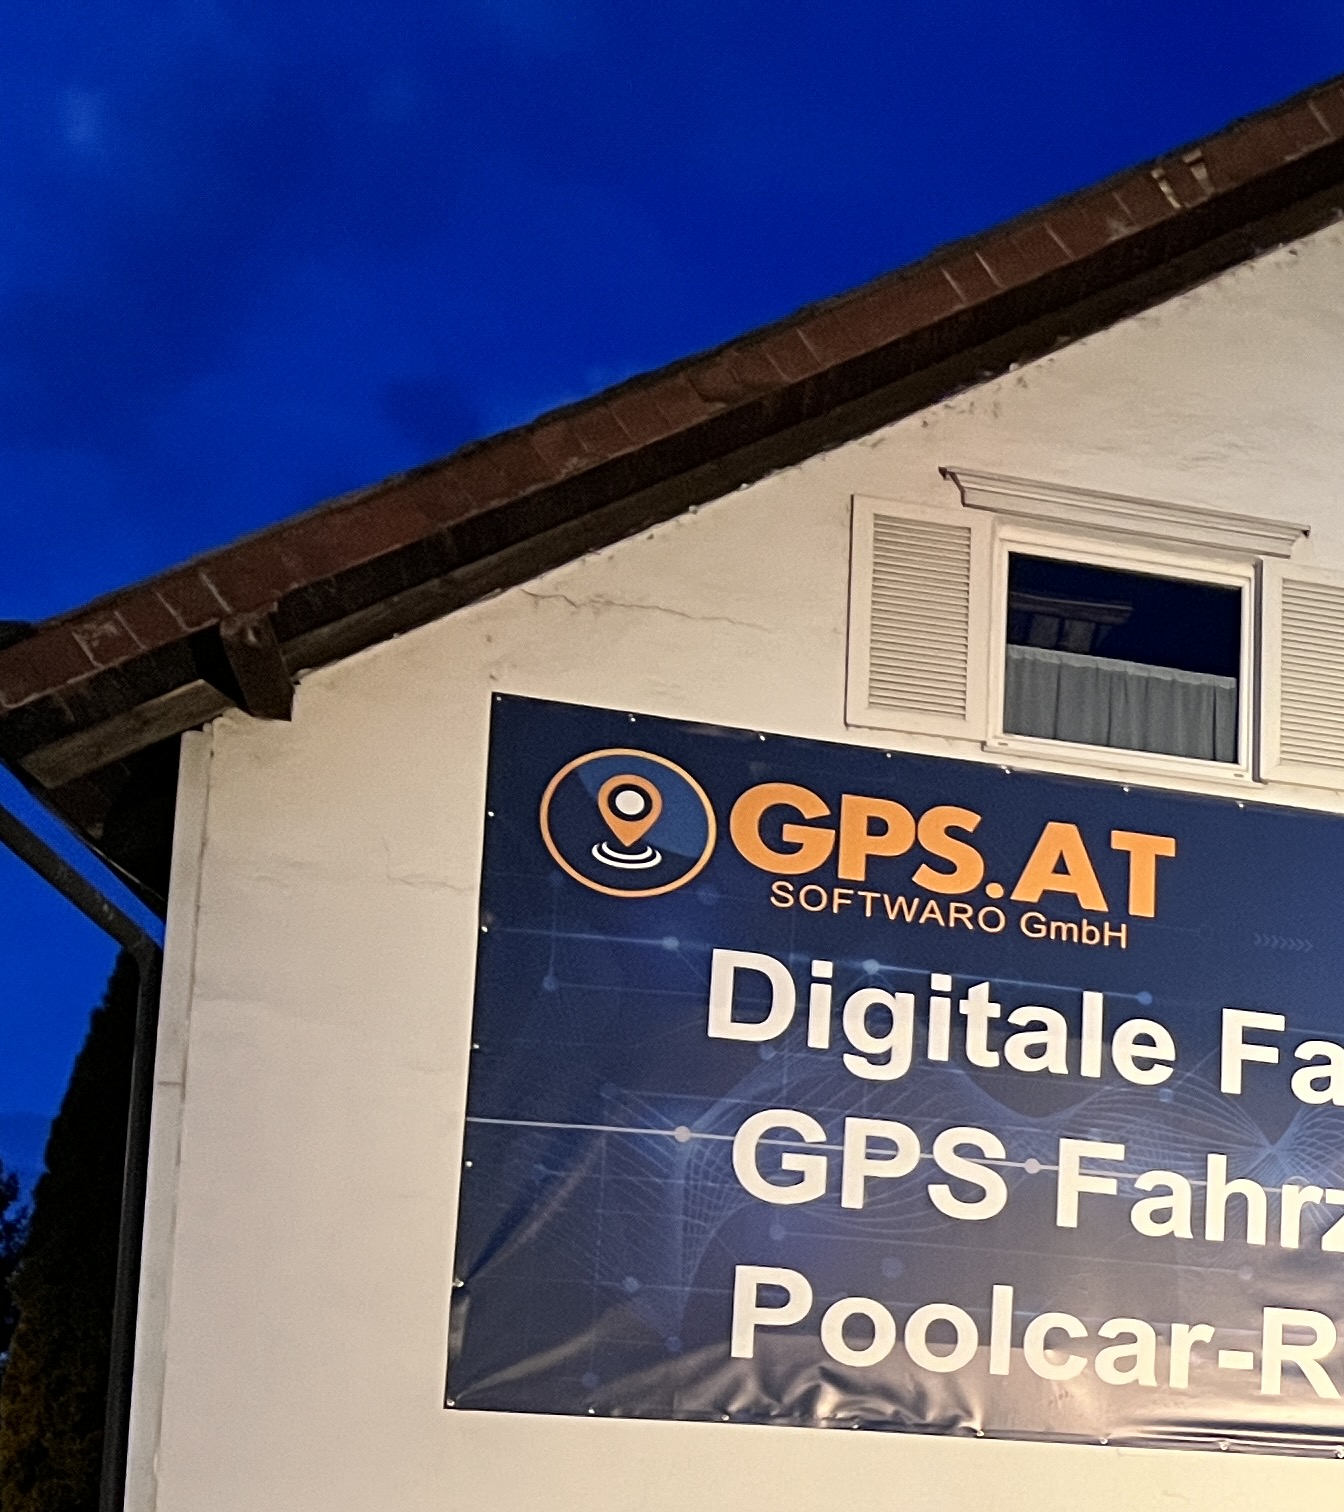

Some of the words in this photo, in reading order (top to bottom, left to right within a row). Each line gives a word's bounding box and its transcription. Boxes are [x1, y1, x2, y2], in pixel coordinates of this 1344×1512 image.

[729, 782, 1177, 919] GPS.AT
[769, 880, 1005, 935] SOFTWARO
[1019, 911, 1128, 949] GmbH
[706, 948, 1177, 1086] Digitale
[731, 1109, 1009, 1222] GPS
